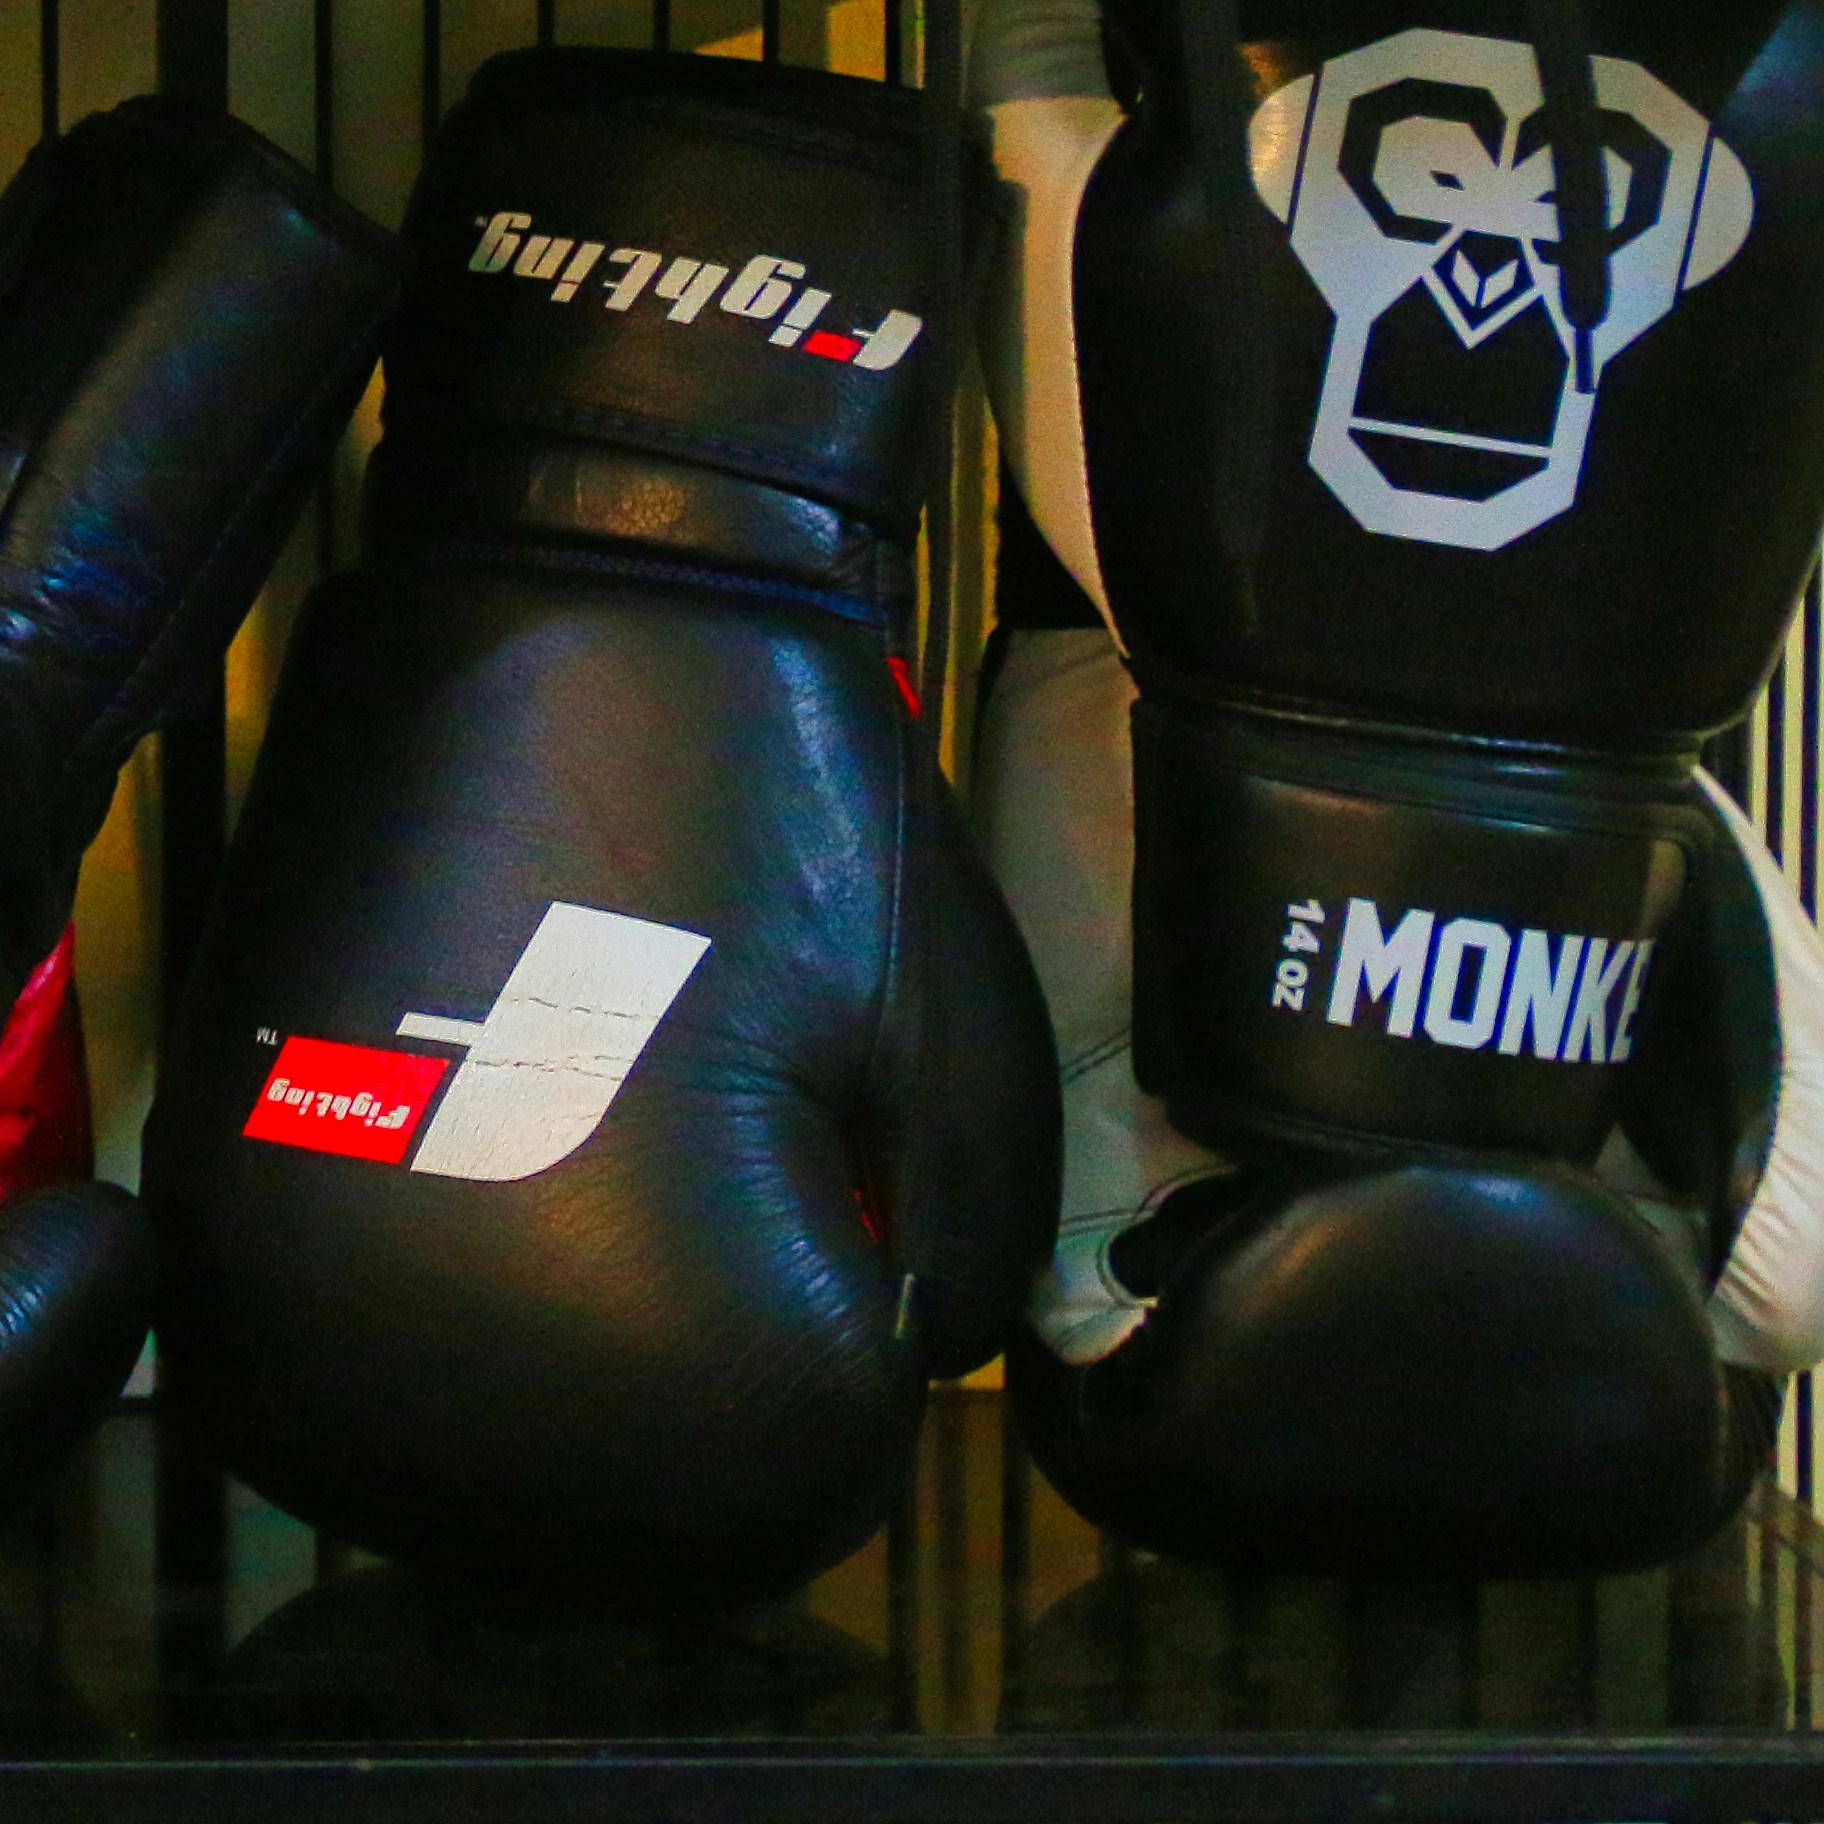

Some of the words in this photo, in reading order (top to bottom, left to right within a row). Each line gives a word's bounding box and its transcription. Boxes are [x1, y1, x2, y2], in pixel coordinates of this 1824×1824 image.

[468, 211, 924, 372] Fighting
[1281, 898, 1327, 955] 14
[267, 1077, 411, 1131] Fighting
